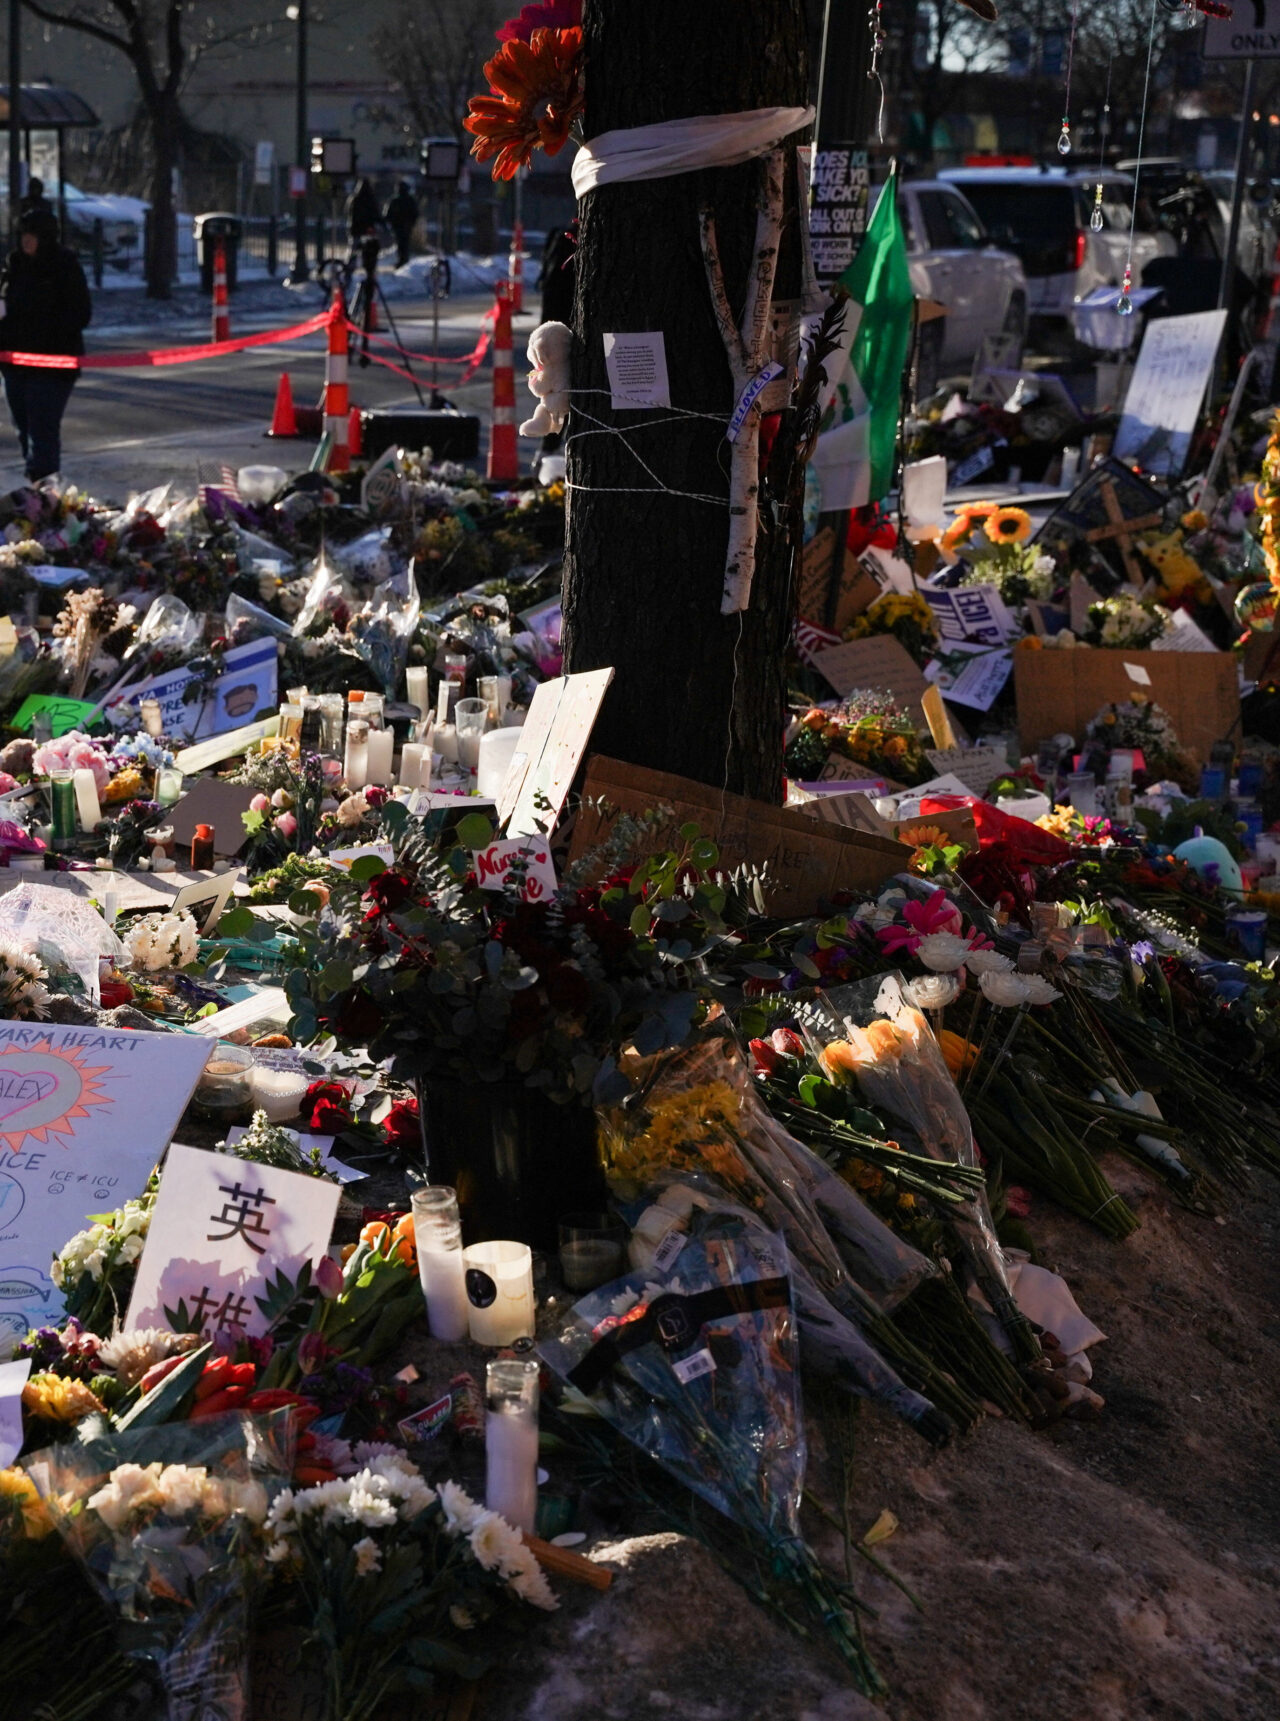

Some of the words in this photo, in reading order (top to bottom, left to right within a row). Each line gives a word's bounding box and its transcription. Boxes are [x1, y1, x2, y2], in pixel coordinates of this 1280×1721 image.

[1231, 33, 1280, 50] ONLY
[817, 186, 861, 202] SICK?
[832, 209, 854, 220] OUT
[729, 371, 771, 434] BELOVED
[60, 1031, 145, 1051] HEART
[49, 1169, 75, 1181] ICE
[91, 1175, 121, 1188] ICU
